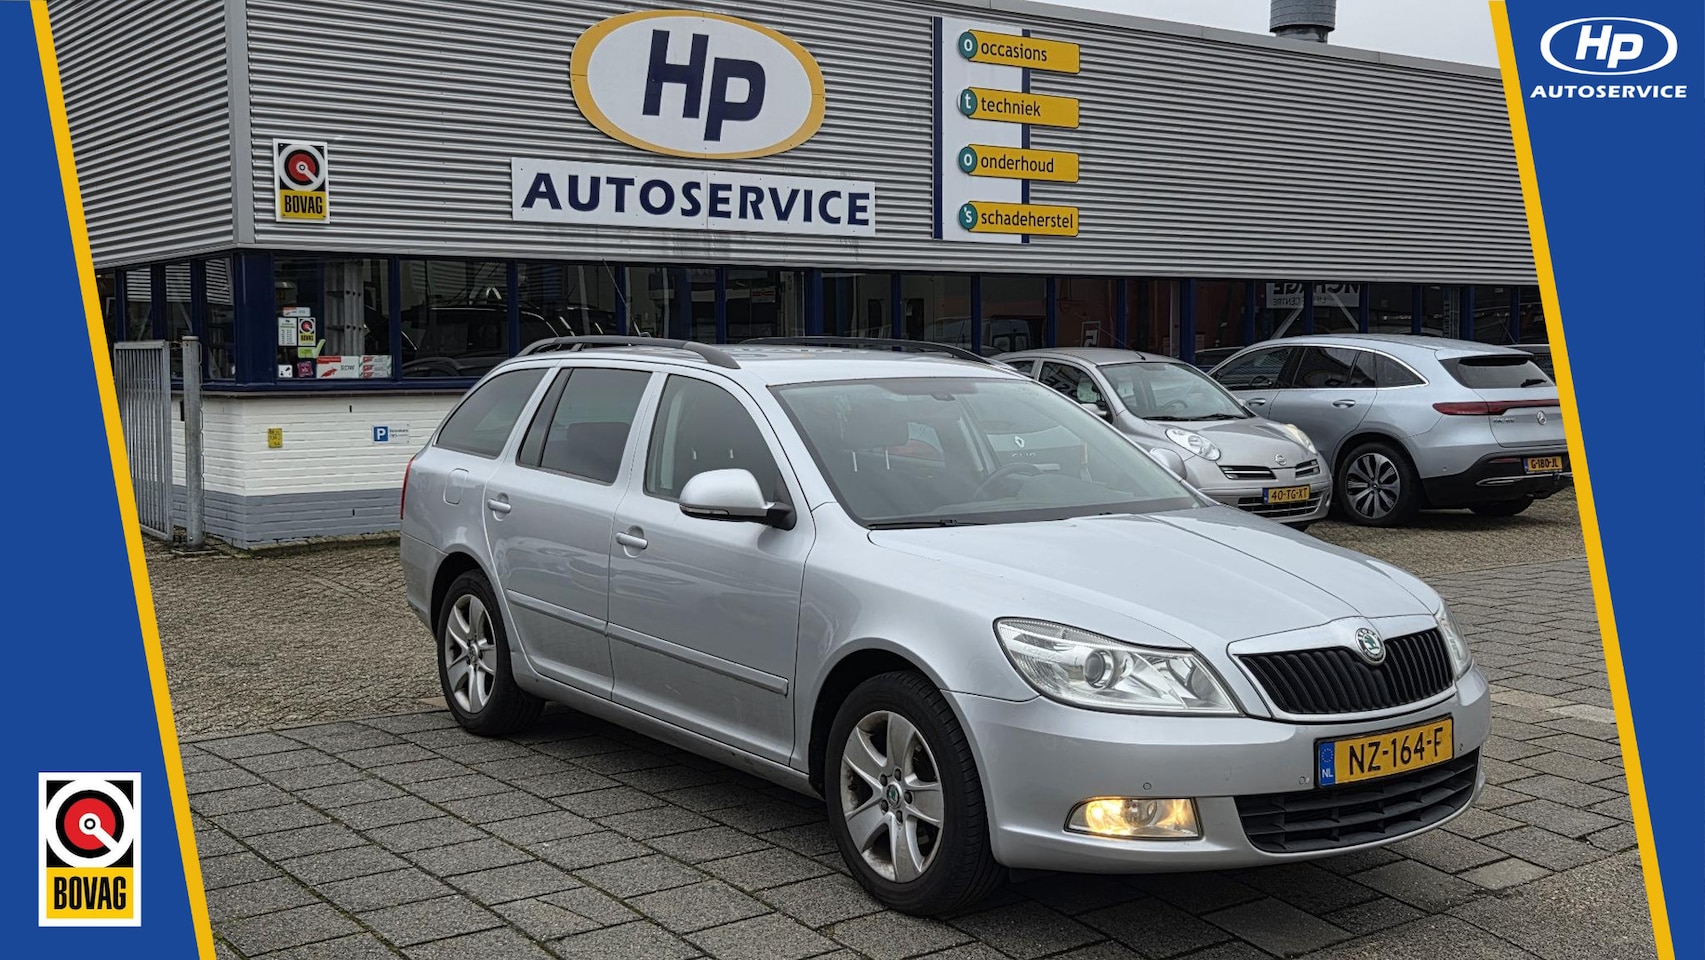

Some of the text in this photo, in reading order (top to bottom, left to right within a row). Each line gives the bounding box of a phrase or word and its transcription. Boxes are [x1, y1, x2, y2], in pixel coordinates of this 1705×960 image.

[981, 43, 1047, 61] occasions
[981, 97, 1041, 117] techniek
[981, 154, 1054, 173] onderhoud
[284, 195, 323, 214] BOVAG
[521, 172, 871, 226] AUTOSERVICE
[981, 209, 1073, 229] schadeherstel
[1271, 487, 1308, 501] 40-TG-XT
[1349, 726, 1444, 776] NZ-164-F
